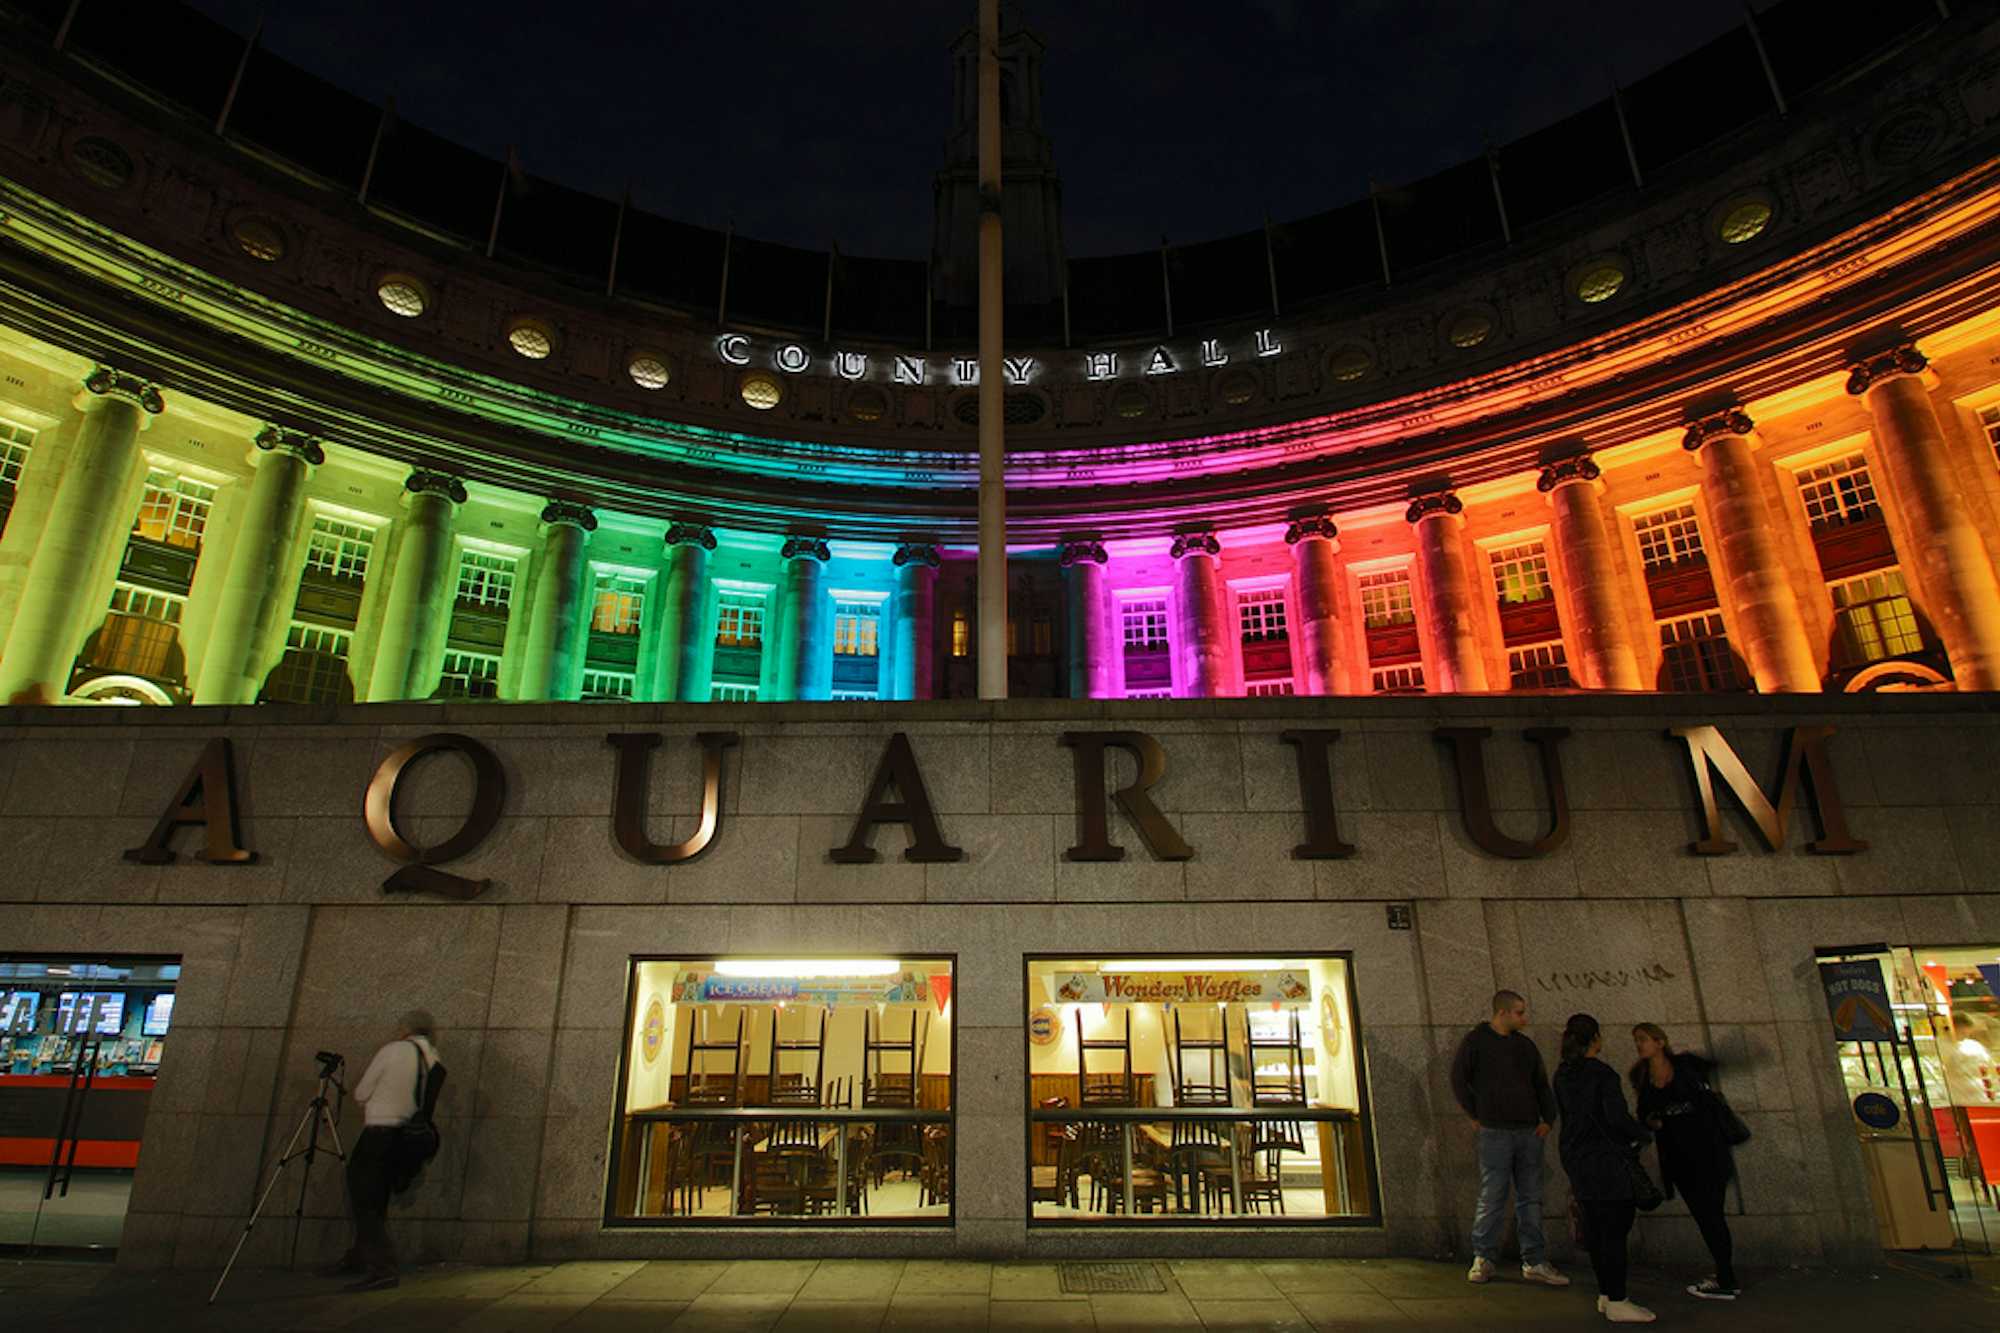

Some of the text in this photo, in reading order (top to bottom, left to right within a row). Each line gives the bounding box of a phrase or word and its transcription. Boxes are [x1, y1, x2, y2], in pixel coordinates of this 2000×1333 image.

[718, 328, 1282, 385] COUNTY HALL
[124, 725, 1869, 899] AQUARIUM
[711, 983, 793, 996] ICE CREAM
